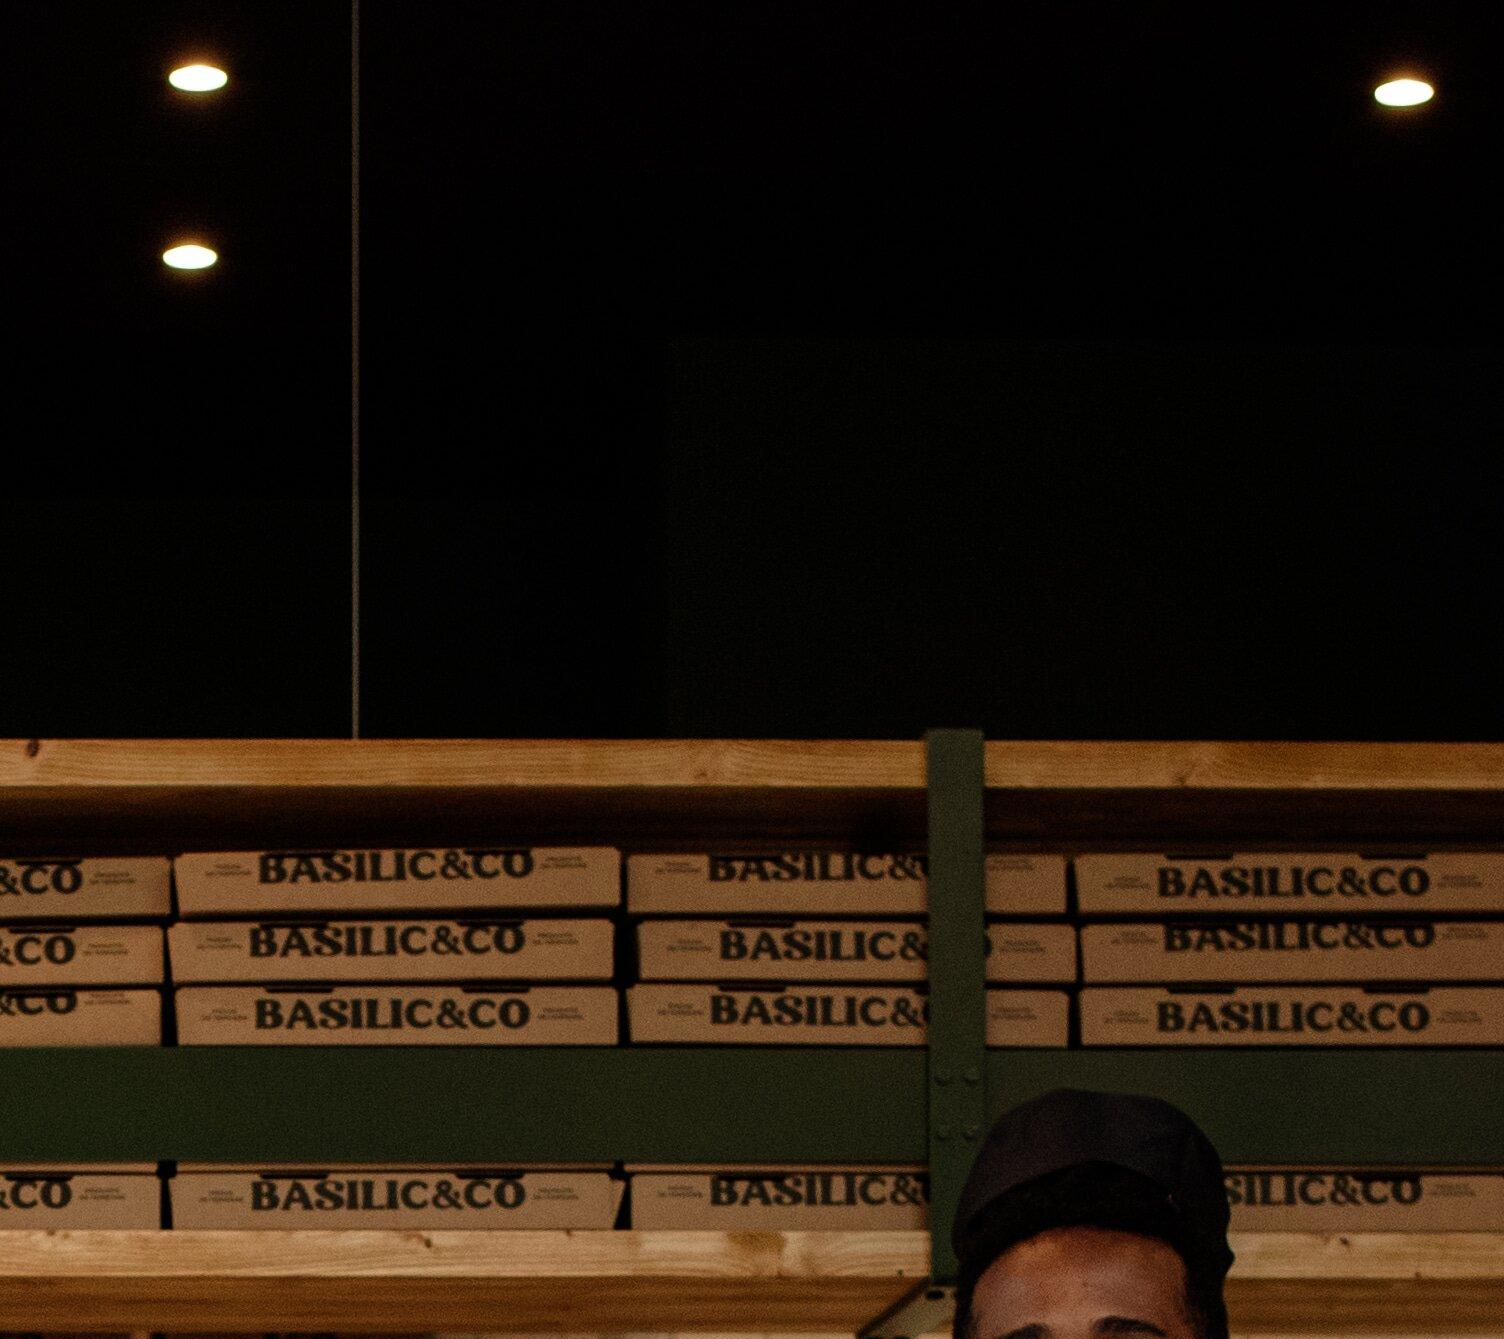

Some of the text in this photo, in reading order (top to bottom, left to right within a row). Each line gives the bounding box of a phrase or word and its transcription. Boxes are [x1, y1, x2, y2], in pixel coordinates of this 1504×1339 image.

[258, 850, 534, 884] BASILIC&CO
[708, 854, 928, 881] BASILIC&
[1157, 866, 1431, 898] BASILIC&CO
[248, 924, 525, 958] BASILIC&CO
[720, 930, 928, 960] BASILIC&
[1163, 922, 1436, 952] BASILIC&CO
[254, 997, 531, 1030] BASILIC&CO
[710, 995, 928, 1026] BASILIC&
[1156, 1002, 1430, 1033] BASILIC&CO
[250, 1179, 526, 1211] BASILIC&CO
[709, 1175, 929, 1206] BASILIC&
[1224, 1175, 1422, 1205] SILIC&CO
